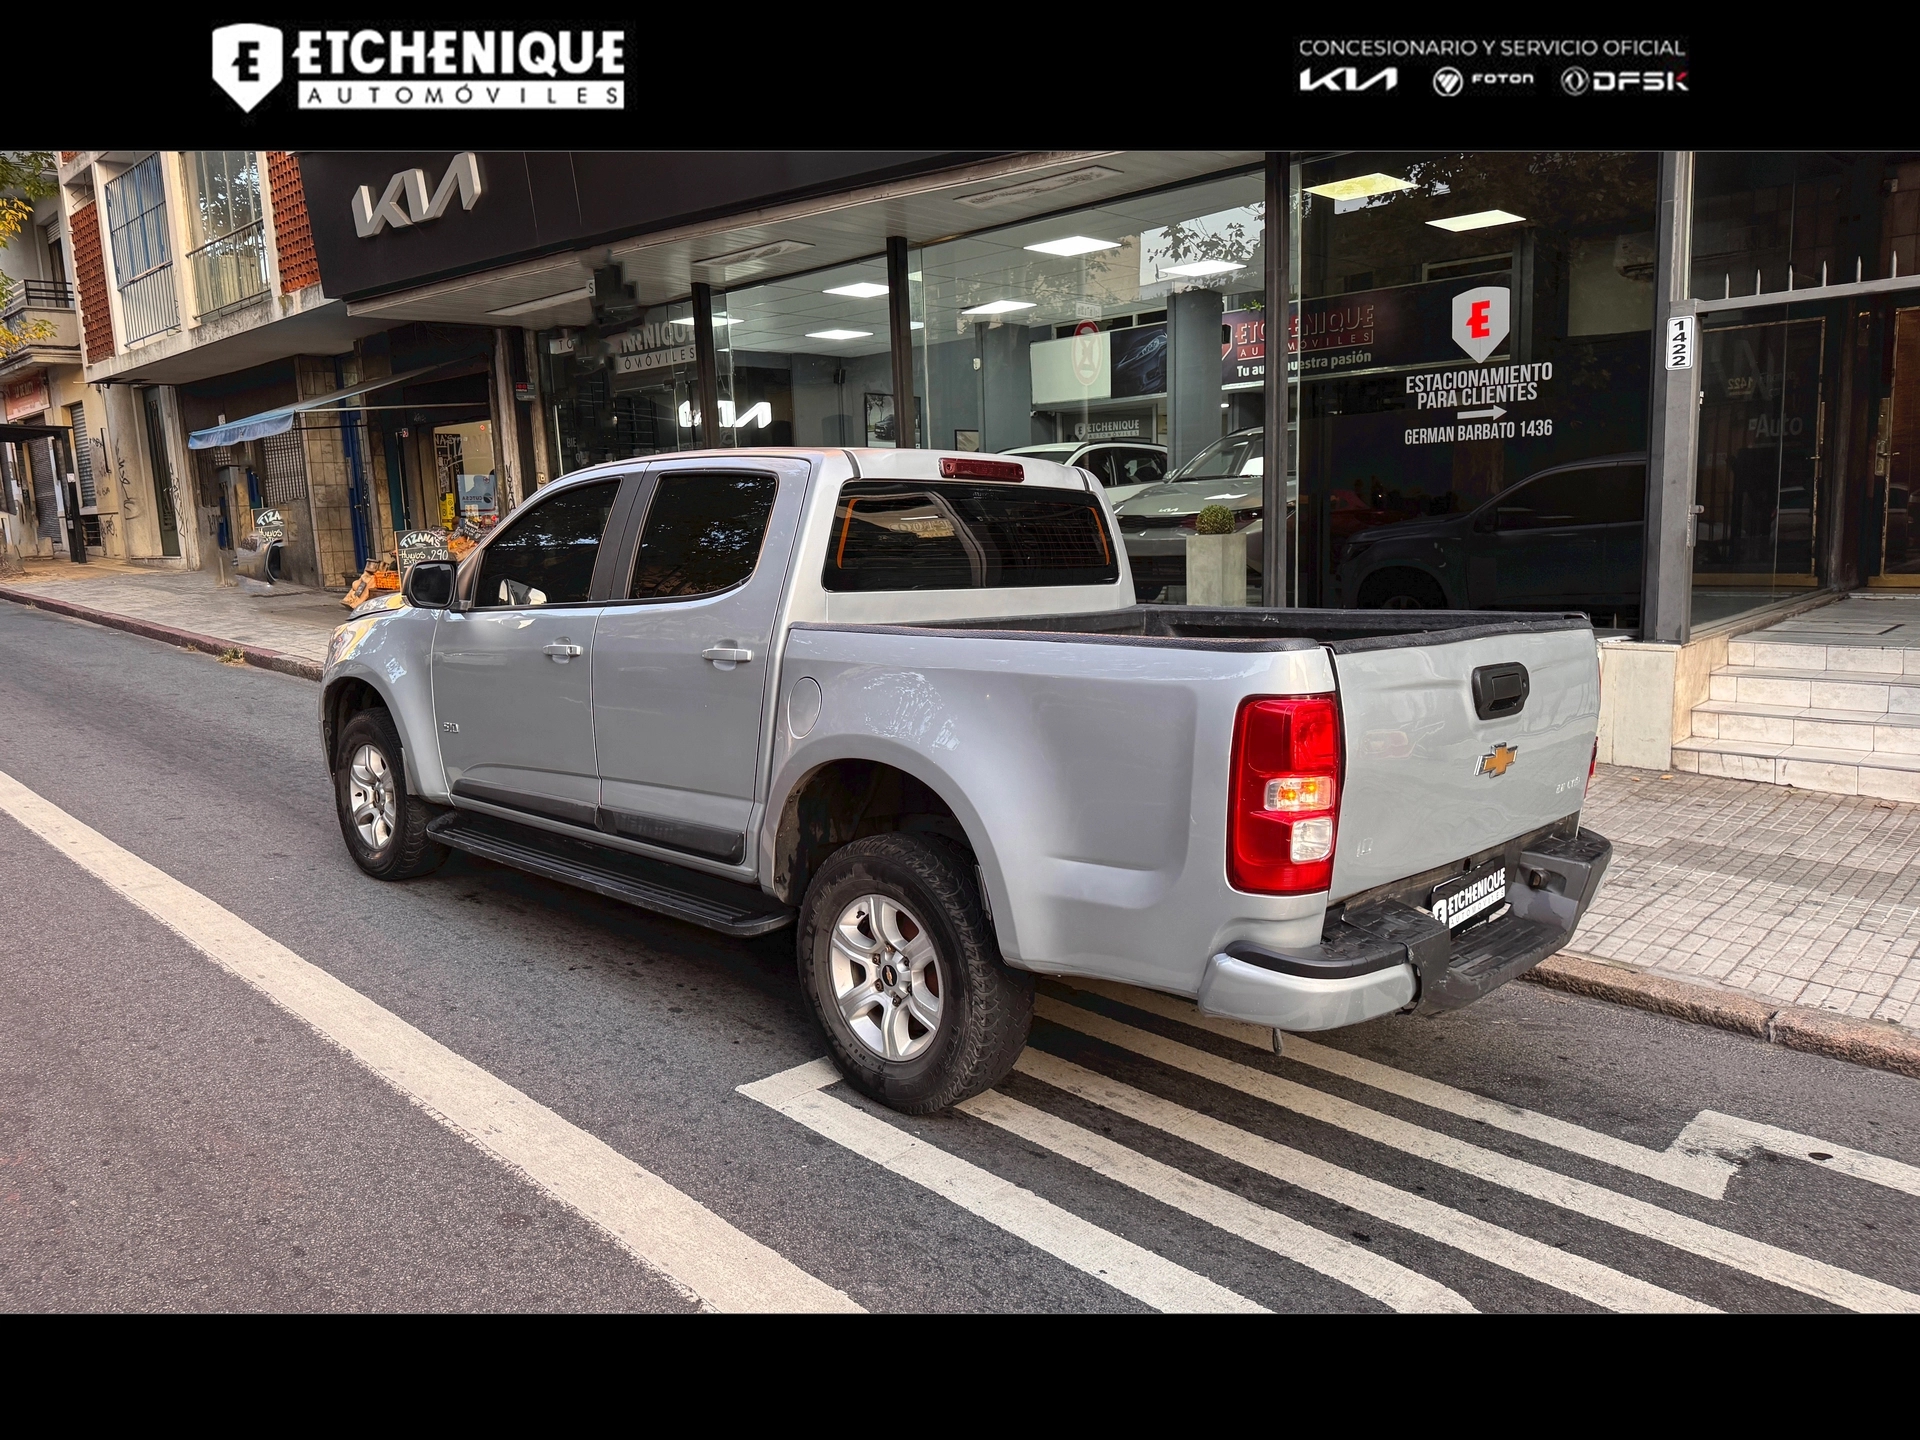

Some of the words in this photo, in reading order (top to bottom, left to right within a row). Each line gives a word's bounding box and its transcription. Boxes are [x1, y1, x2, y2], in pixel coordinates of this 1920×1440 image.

[351, 151, 482, 238] KIA
[1672, 320, 1687, 366] 1422
[1236, 365, 1250, 377] Tu
[1331, 350, 1372, 369] pasión
[1405, 361, 1553, 394] ESTACIONAMIENTO
[1417, 389, 1458, 410] PARA
[1462, 381, 1538, 406] CLIENTES
[1087, 420, 1140, 433] ETCHENIQUE
[1404, 425, 1455, 445] GERMAN
[1457, 421, 1516, 442] BARBATO
[1519, 418, 1553, 438] 1436
[1447, 867, 1506, 916] ETCHENIQUE
